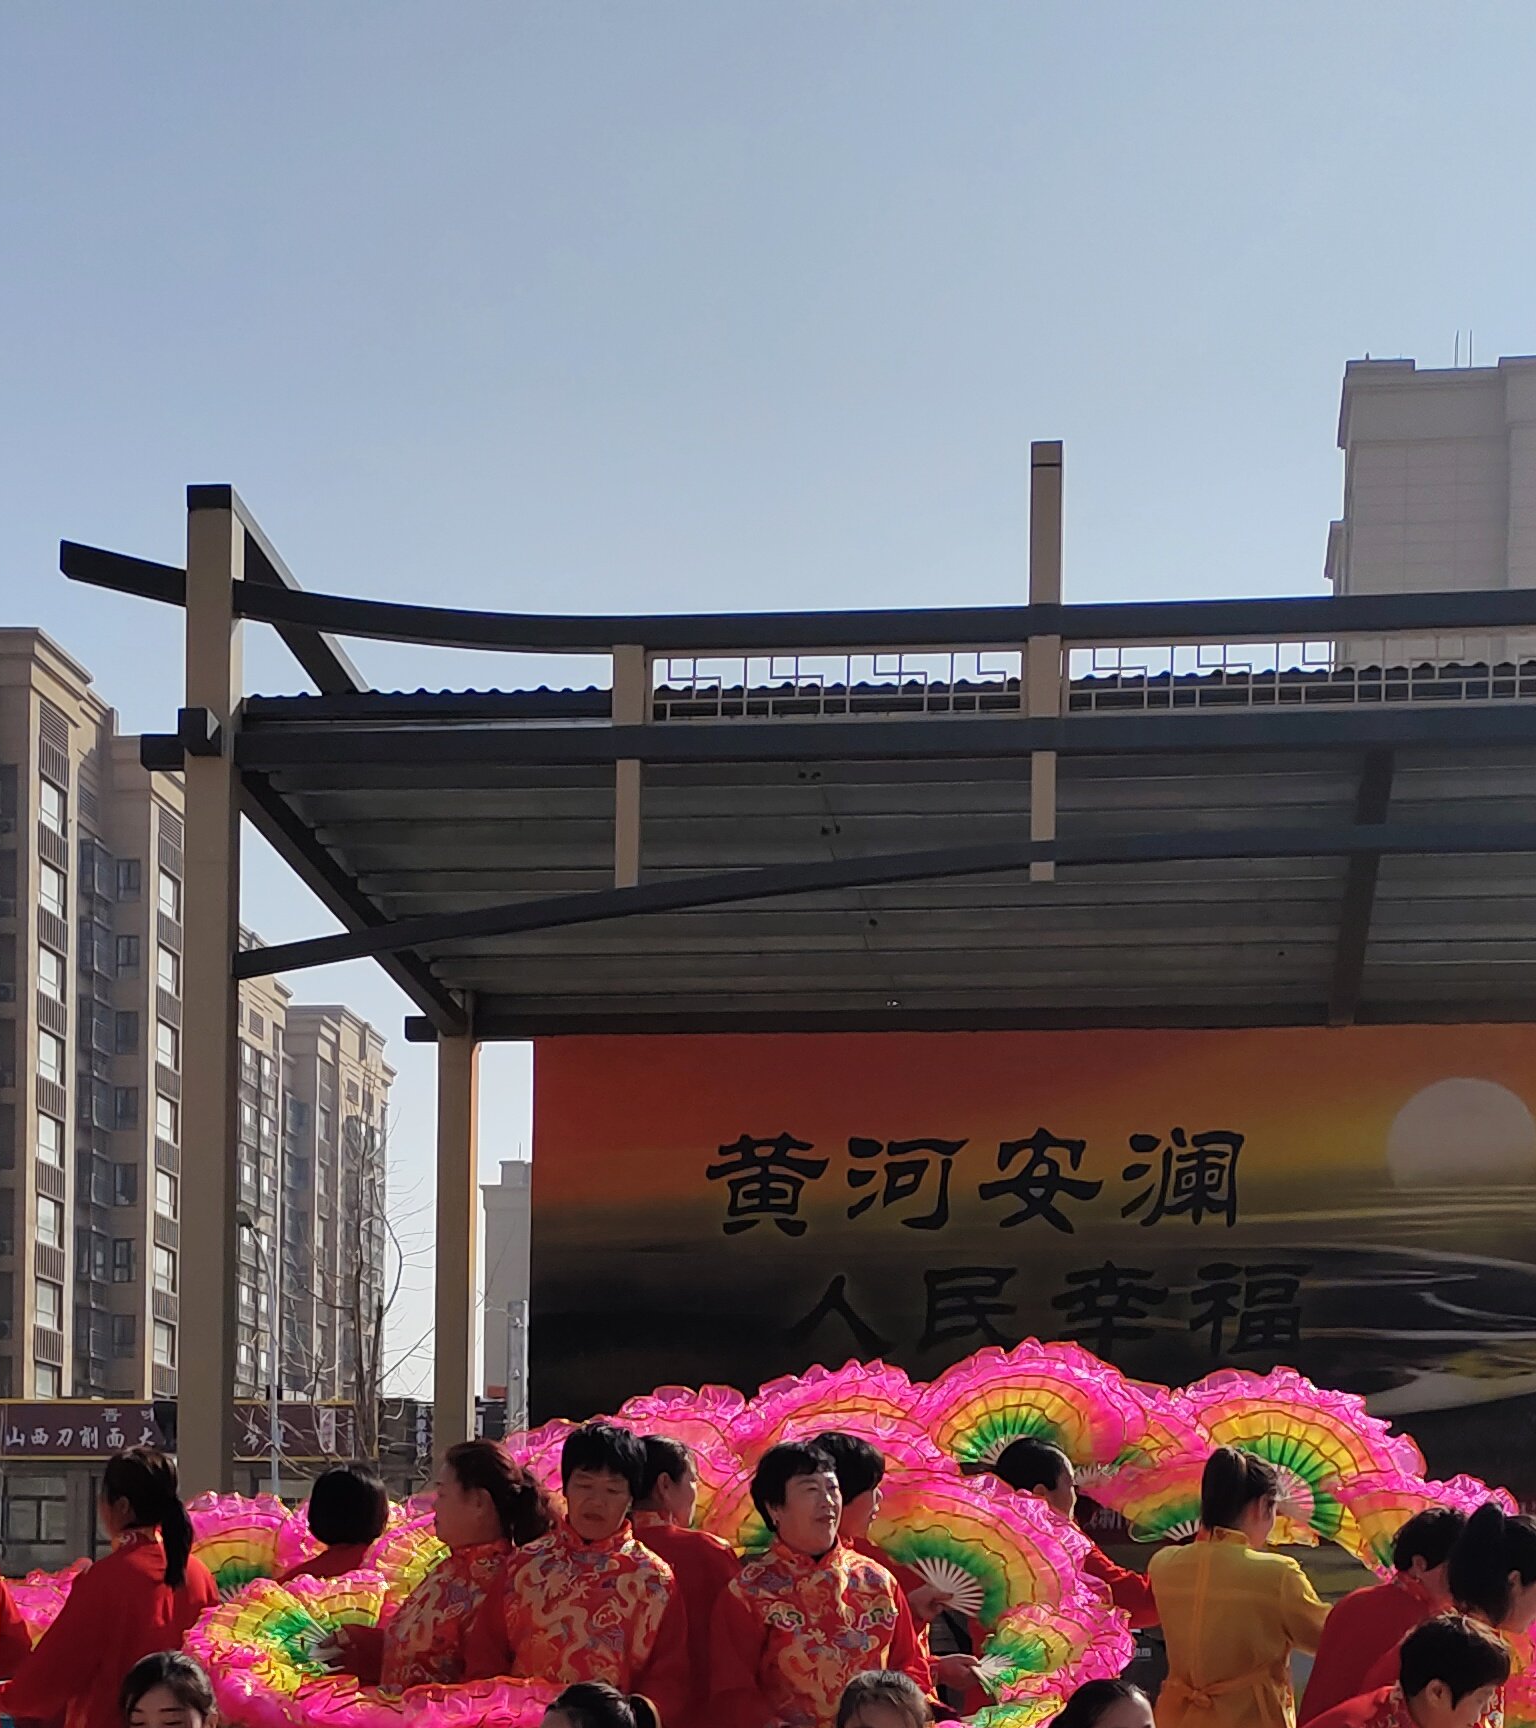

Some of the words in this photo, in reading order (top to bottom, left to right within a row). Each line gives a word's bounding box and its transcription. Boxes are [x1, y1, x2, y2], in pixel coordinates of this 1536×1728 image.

[706, 1127, 1244, 1237] 黄河安澜
[782, 1260, 1314, 1358] 人民幸福
[5, 1426, 156, 1450] 山西刀削面大
